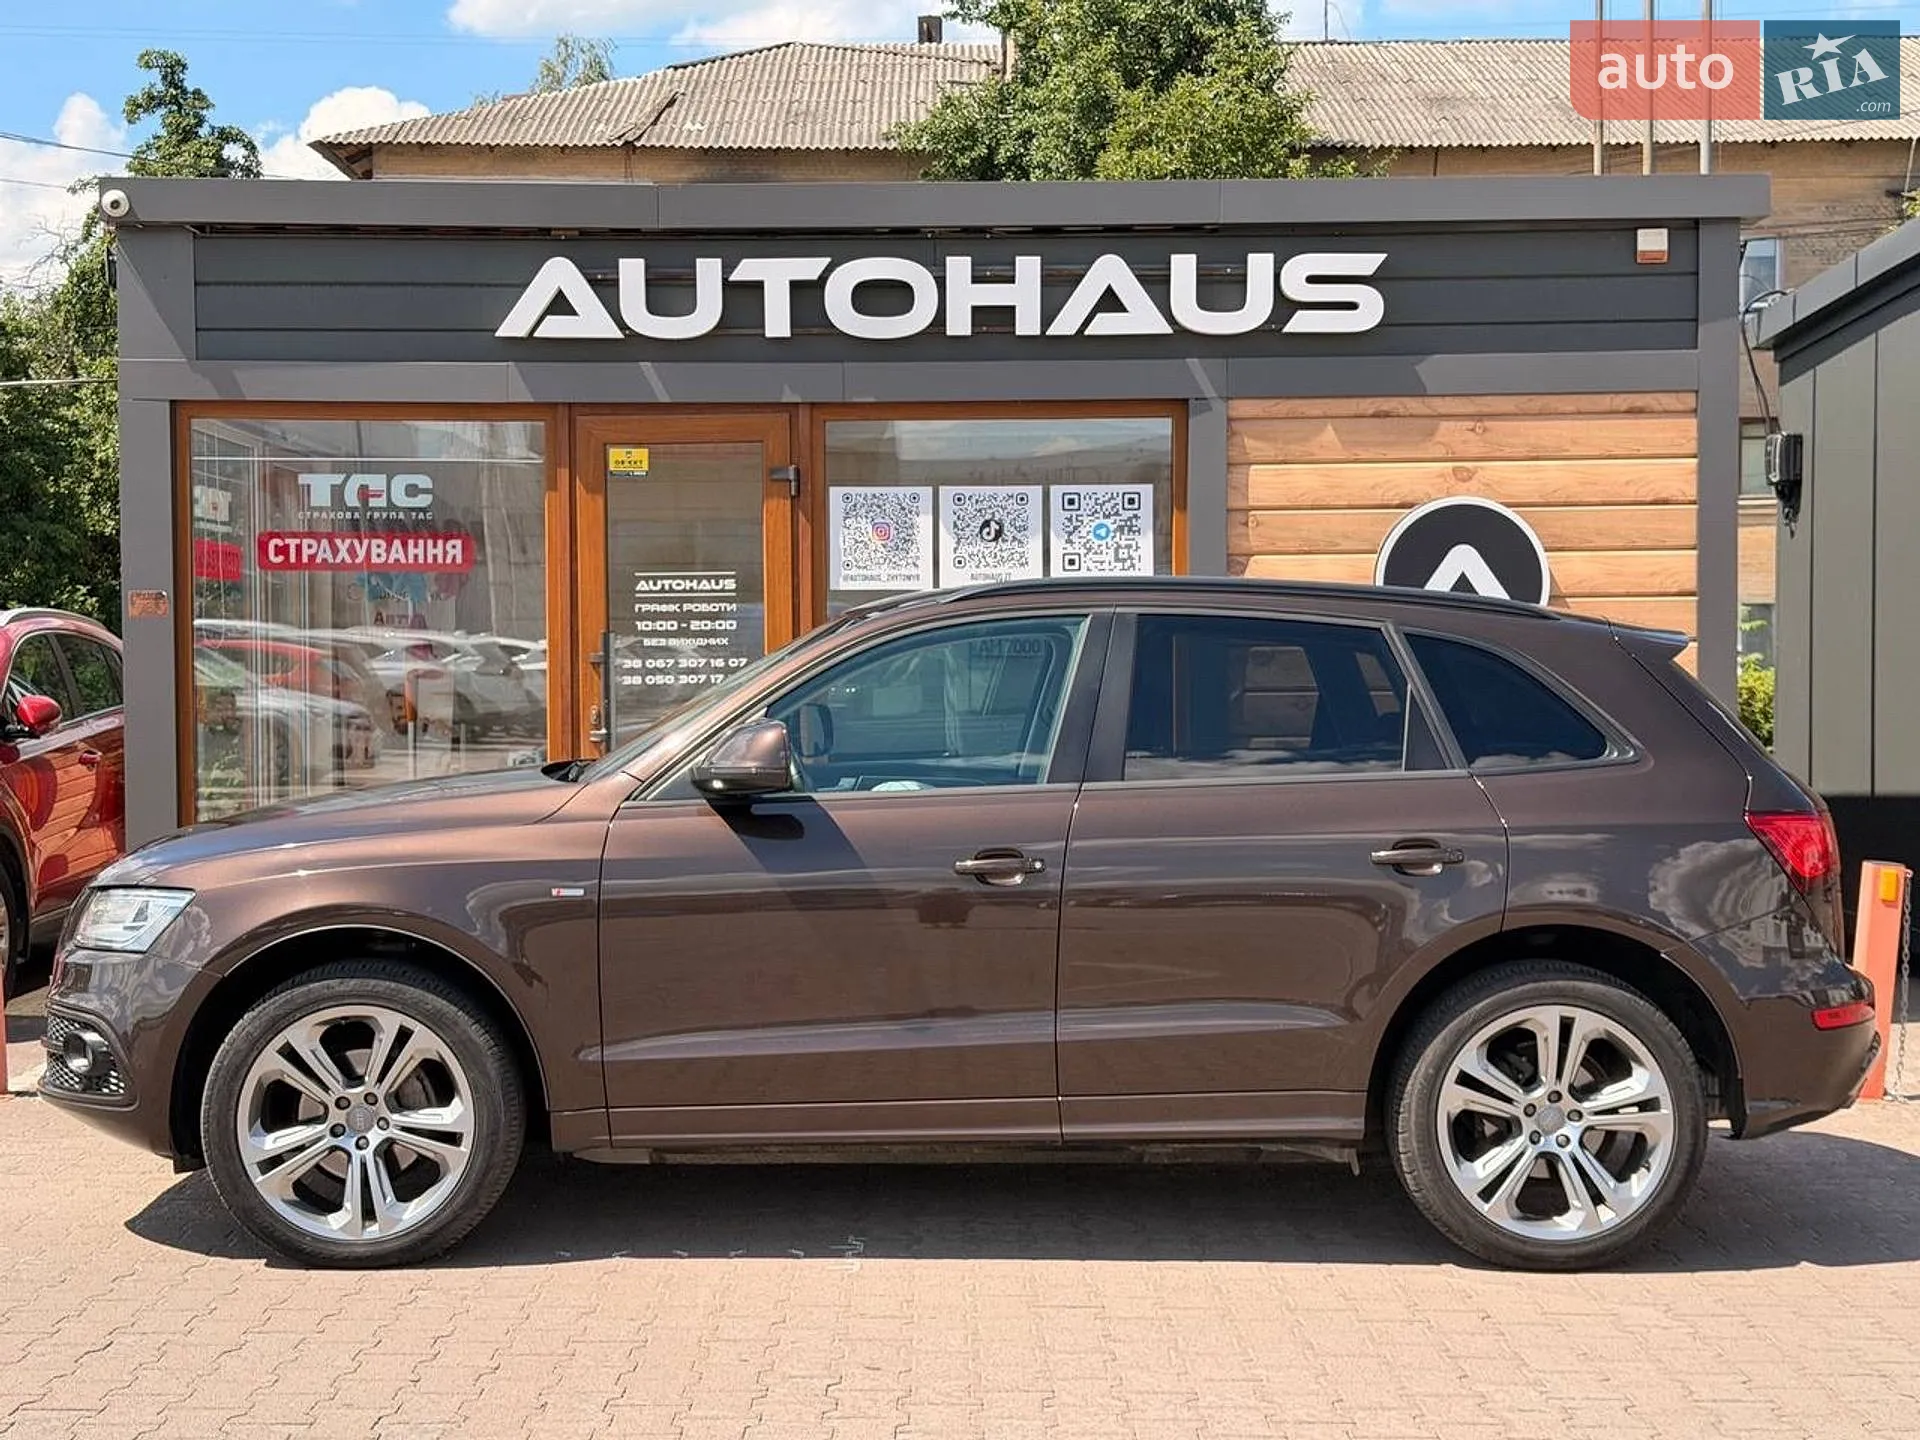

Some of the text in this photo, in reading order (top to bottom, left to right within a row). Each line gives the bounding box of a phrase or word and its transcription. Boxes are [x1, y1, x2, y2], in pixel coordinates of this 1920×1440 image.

[494, 252, 1389, 340] AUTOHAUS
[366, 511, 405, 520] ГРУПА
[267, 537, 463, 564] СТРАХУВАННЯ
[635, 579, 737, 591] AUTOHAUS
[682, 603, 737, 612] РОБОТИ
[636, 621, 678, 631] 10:00
[690, 620, 737, 630] 20:00
[645, 659, 675, 668] 067
[678, 659, 706, 668] 307
[710, 659, 725, 667] 16
[728, 658, 748, 667] 07
[644, 675, 675, 685] 050
[678, 675, 706, 684] 307
